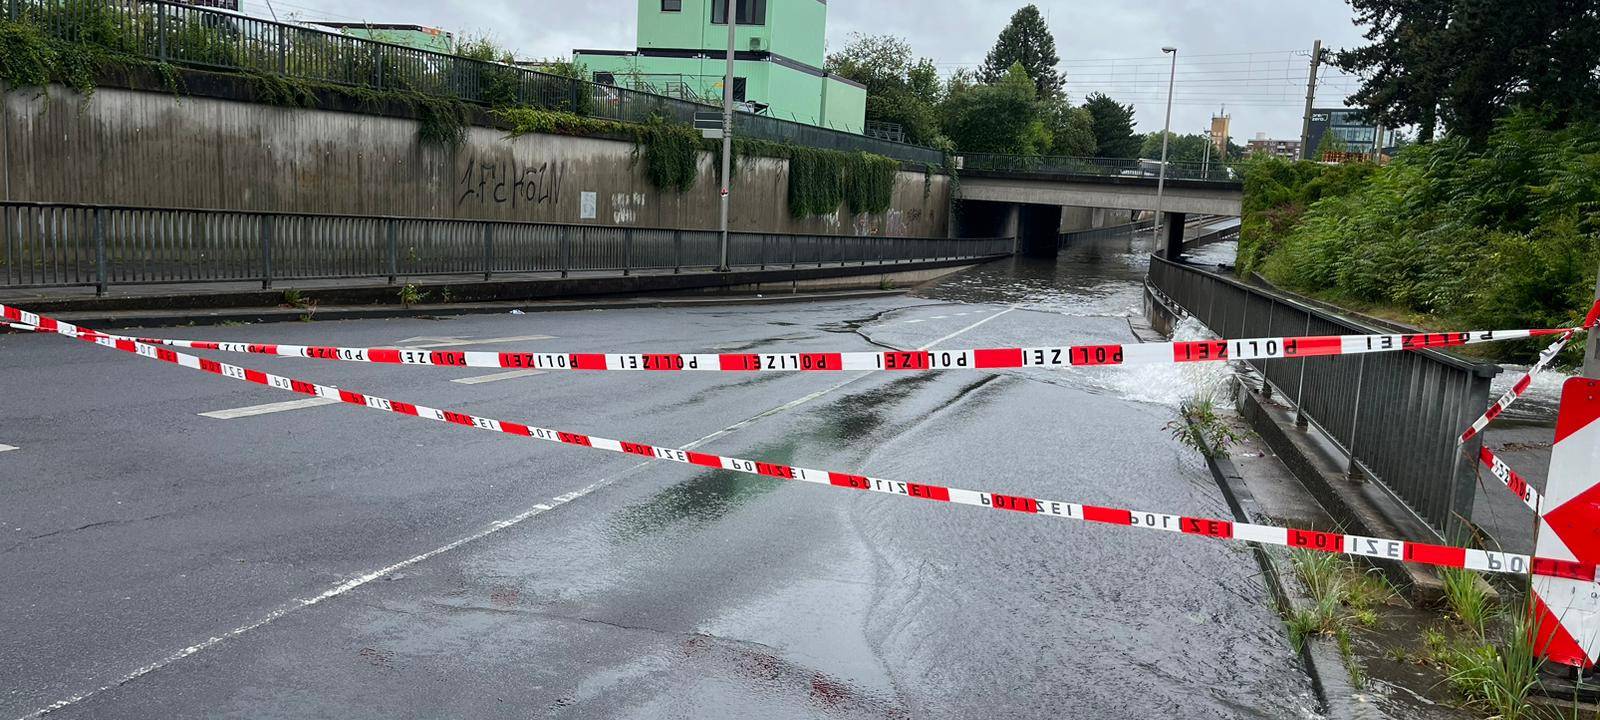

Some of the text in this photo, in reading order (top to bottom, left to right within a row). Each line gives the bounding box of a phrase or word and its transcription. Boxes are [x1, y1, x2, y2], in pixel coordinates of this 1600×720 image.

[301, 347, 364, 361] POLIZEI
[399, 351, 467, 365] POLIZEI
[506, 354, 578, 369] POLIZEI
[621, 355, 697, 369] POLIZEI
[744, 355, 826, 369] POLIZEI
[877, 352, 967, 368] POLIZEI
[1023, 346, 1124, 365] POLIZEI
[1186, 339, 1297, 359] POLIZEI
[1367, 331, 1493, 350] POLIZEI
